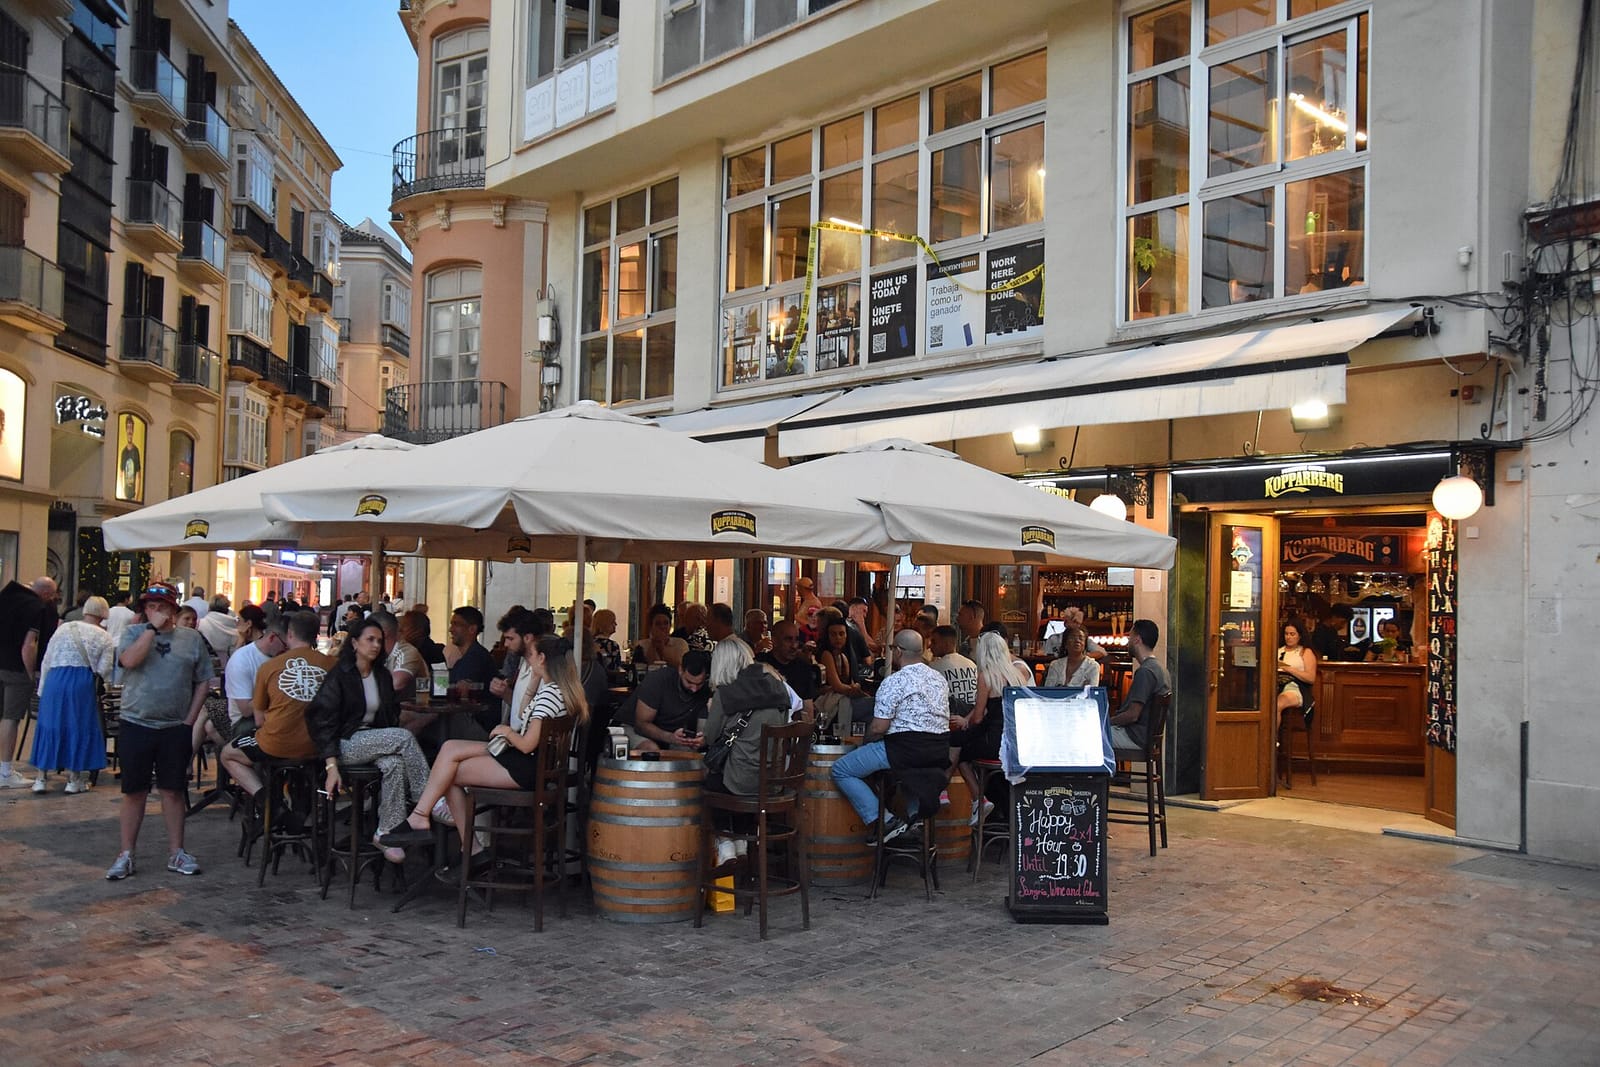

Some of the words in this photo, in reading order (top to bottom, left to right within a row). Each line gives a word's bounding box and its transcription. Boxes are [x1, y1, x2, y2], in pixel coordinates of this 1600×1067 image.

[938, 259, 977, 273] momentum
[991, 256, 1017, 269] WORK
[991, 267, 1016, 280] HERE.
[872, 278, 893, 291] JOIN
[895, 274, 908, 286] US
[931, 283, 959, 296] Trabaja
[872, 285, 901, 300] TODAY
[930, 297, 952, 307] como
[953, 293, 963, 303] un
[990, 289, 1016, 301] DONE.
[872, 302, 902, 317] ÚNETE
[930, 304, 961, 320] ganador
[872, 314, 890, 327] HOY
[1264, 470, 1344, 498] KOPPARBERG
[1283, 536, 1375, 563] KOPPARBERG
[1027, 808, 1075, 836] Happy
[1069, 824, 1093, 843] 2x1
[1035, 832, 1067, 855] Hour
[1022, 853, 1048, 872] Until
